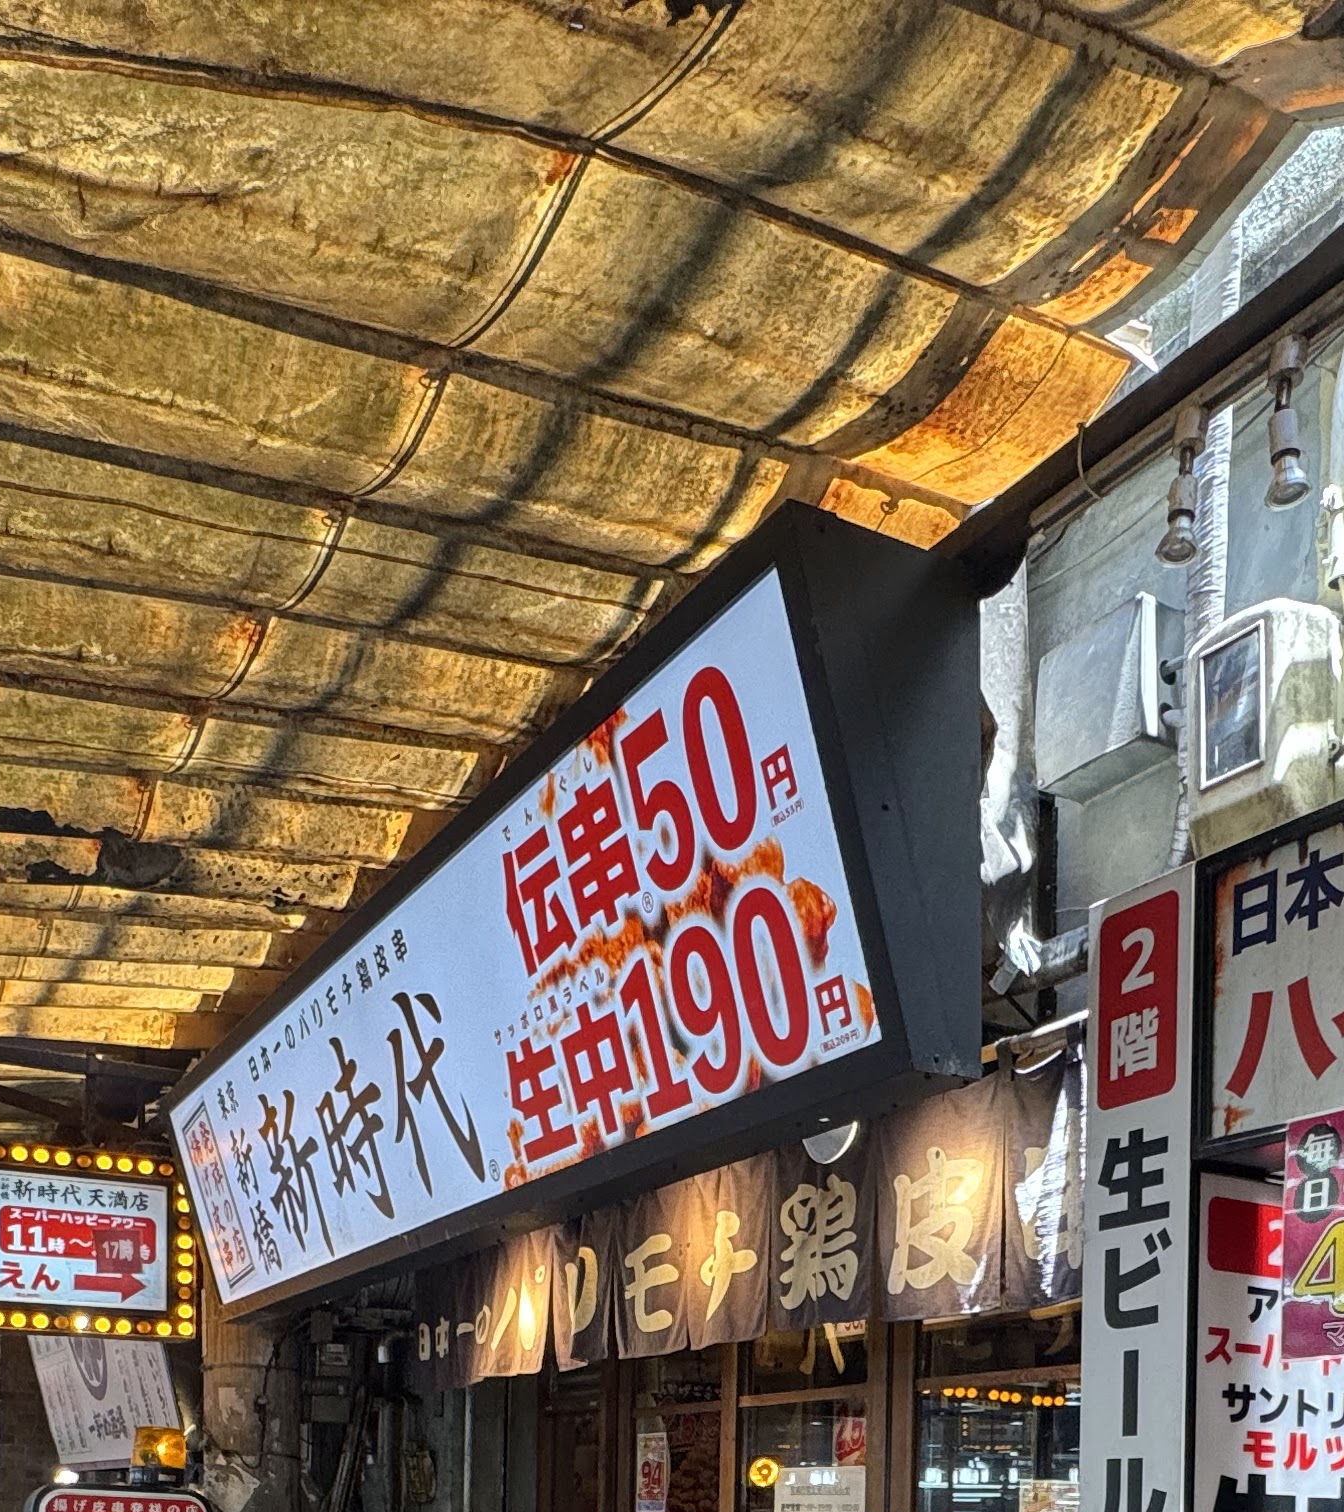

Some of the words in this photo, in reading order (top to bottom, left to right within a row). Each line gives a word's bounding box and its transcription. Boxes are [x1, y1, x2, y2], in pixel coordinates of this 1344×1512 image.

[1109, 927, 1158, 1082] 2階
[258, 992, 485, 1258] 新時代
[11, 1179, 82, 1206] 新時代
[87, 1188, 150, 1212] 天満店
[1302, 1133, 1336, 1214] 毎日
[9, 1207, 147, 1229] スーパーハッピーアワー
